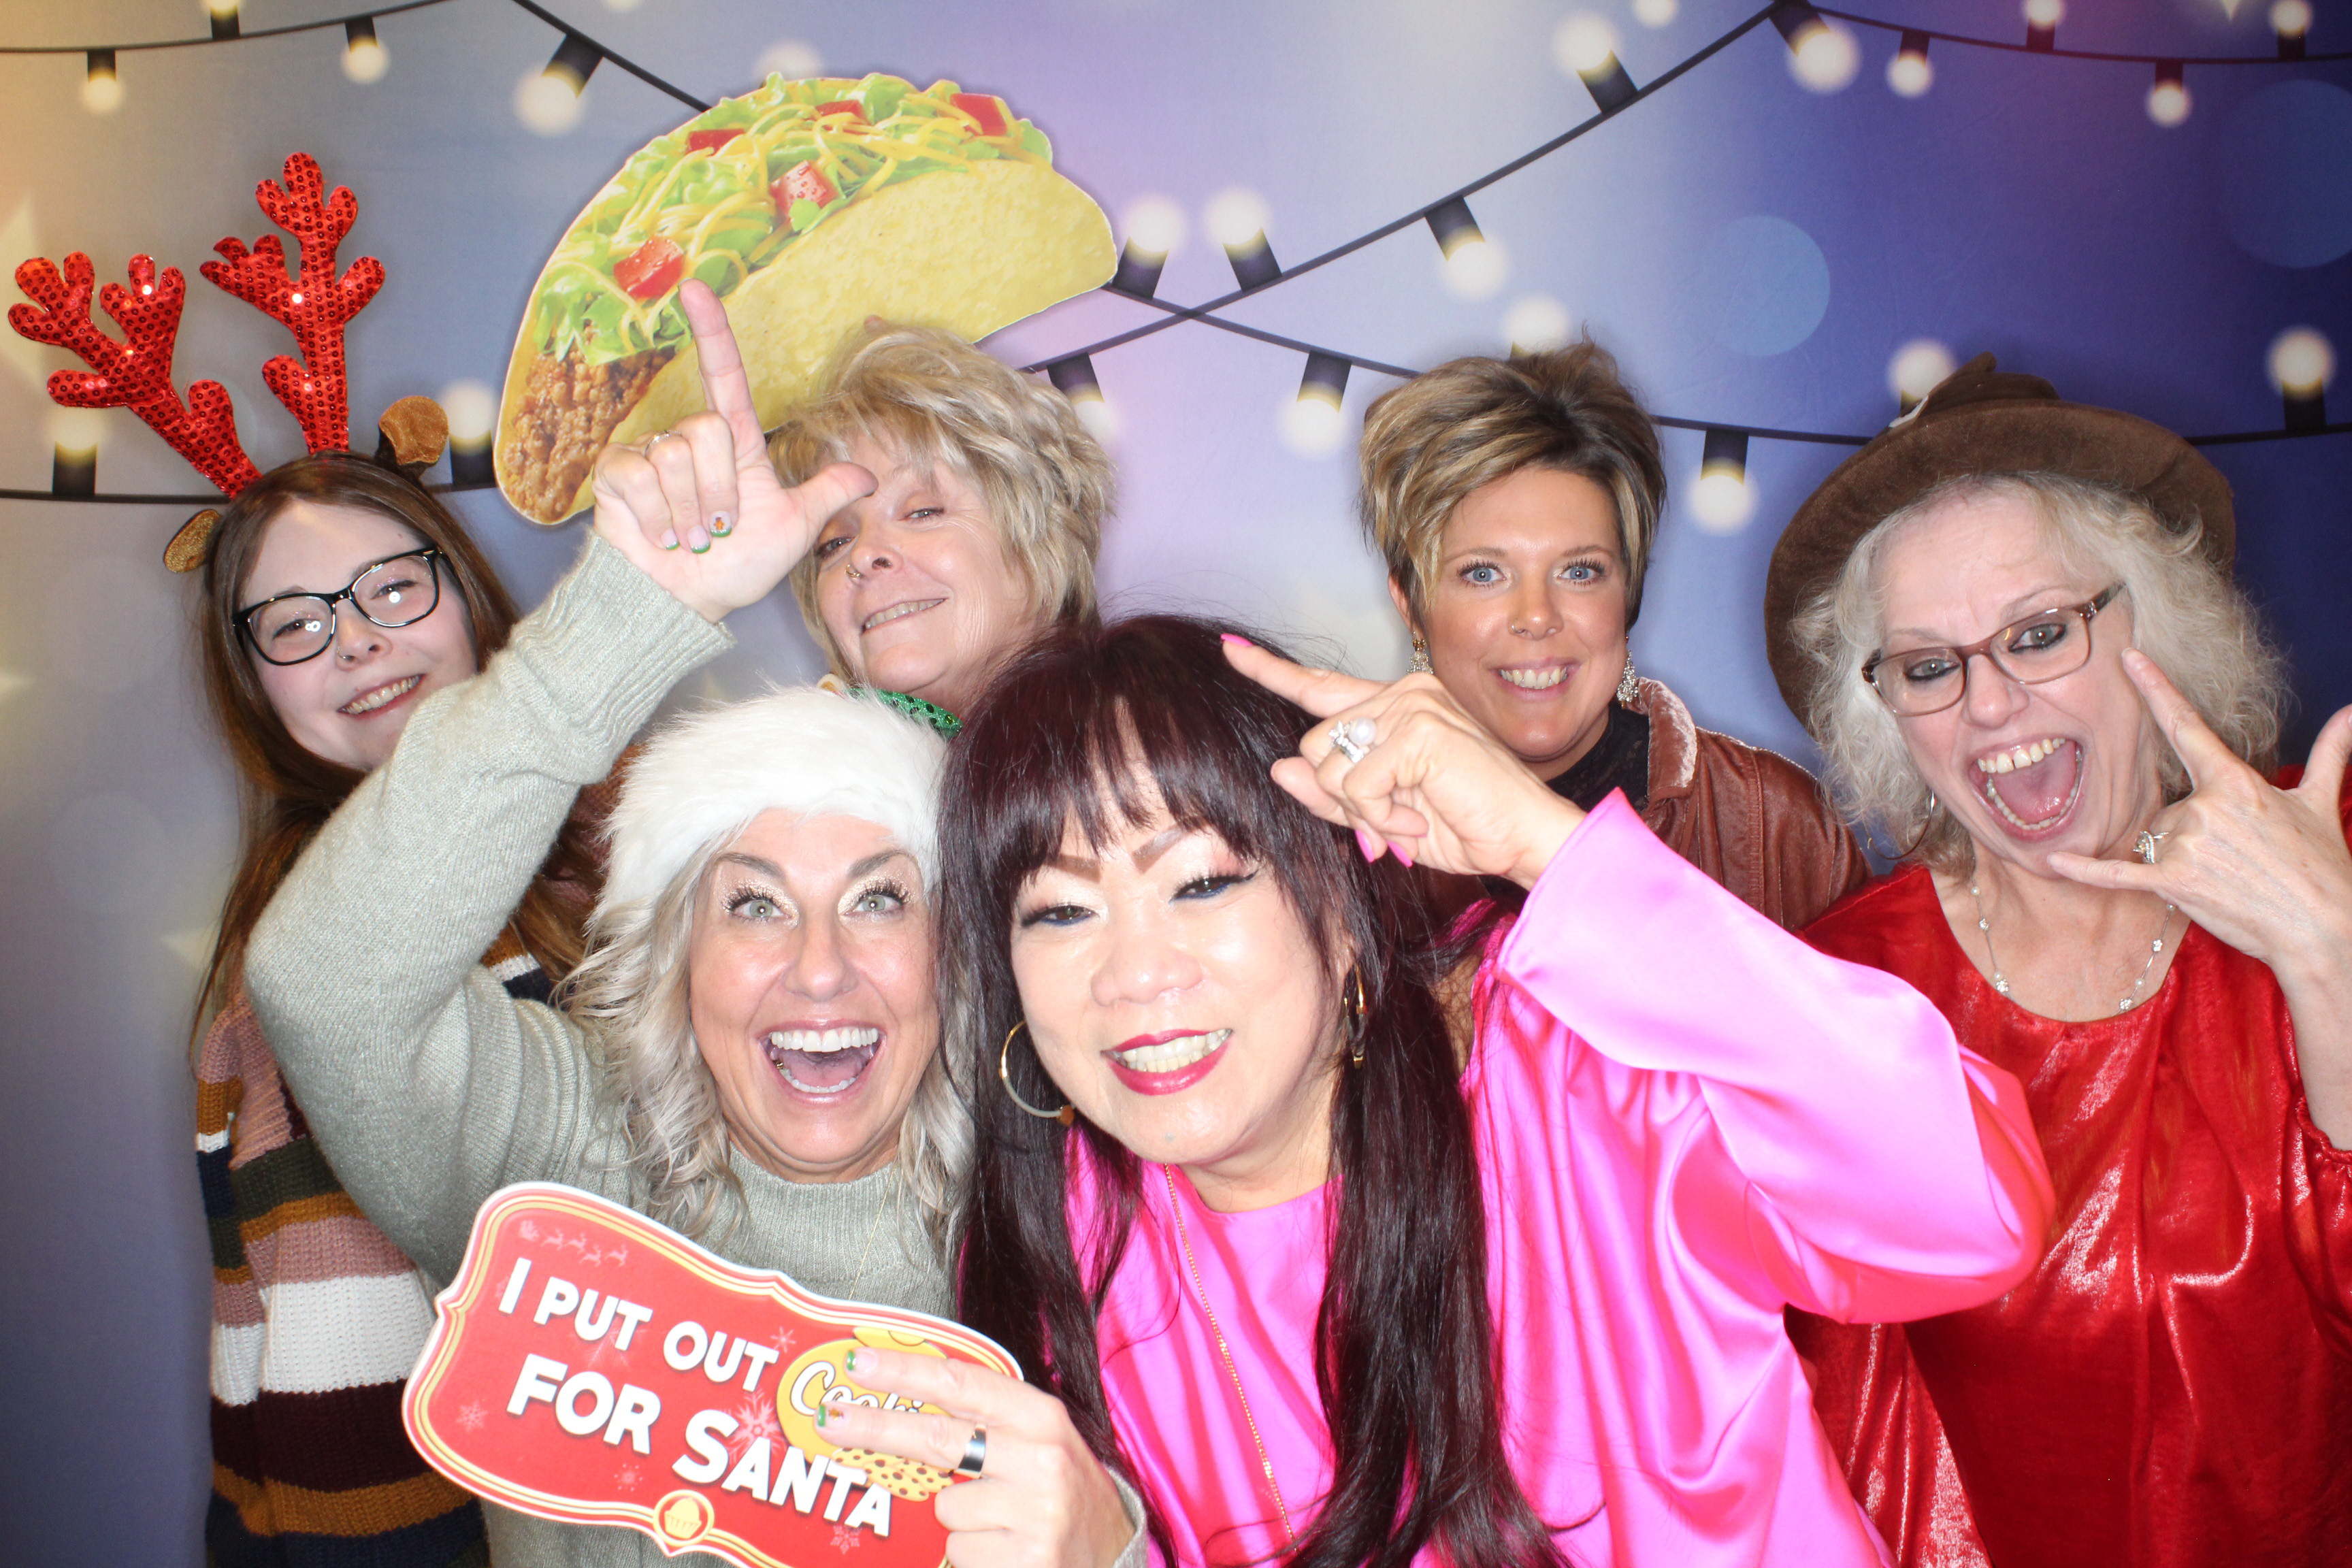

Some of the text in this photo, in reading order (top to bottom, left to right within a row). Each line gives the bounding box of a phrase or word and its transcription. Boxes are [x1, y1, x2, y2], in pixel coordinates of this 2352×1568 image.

[498, 1257, 533, 1315] I
[534, 1276, 653, 1352] PUT
[663, 1321, 780, 1392] OUT
[506, 1354, 662, 1455] FOR
[671, 1409, 892, 1537] SANTA
